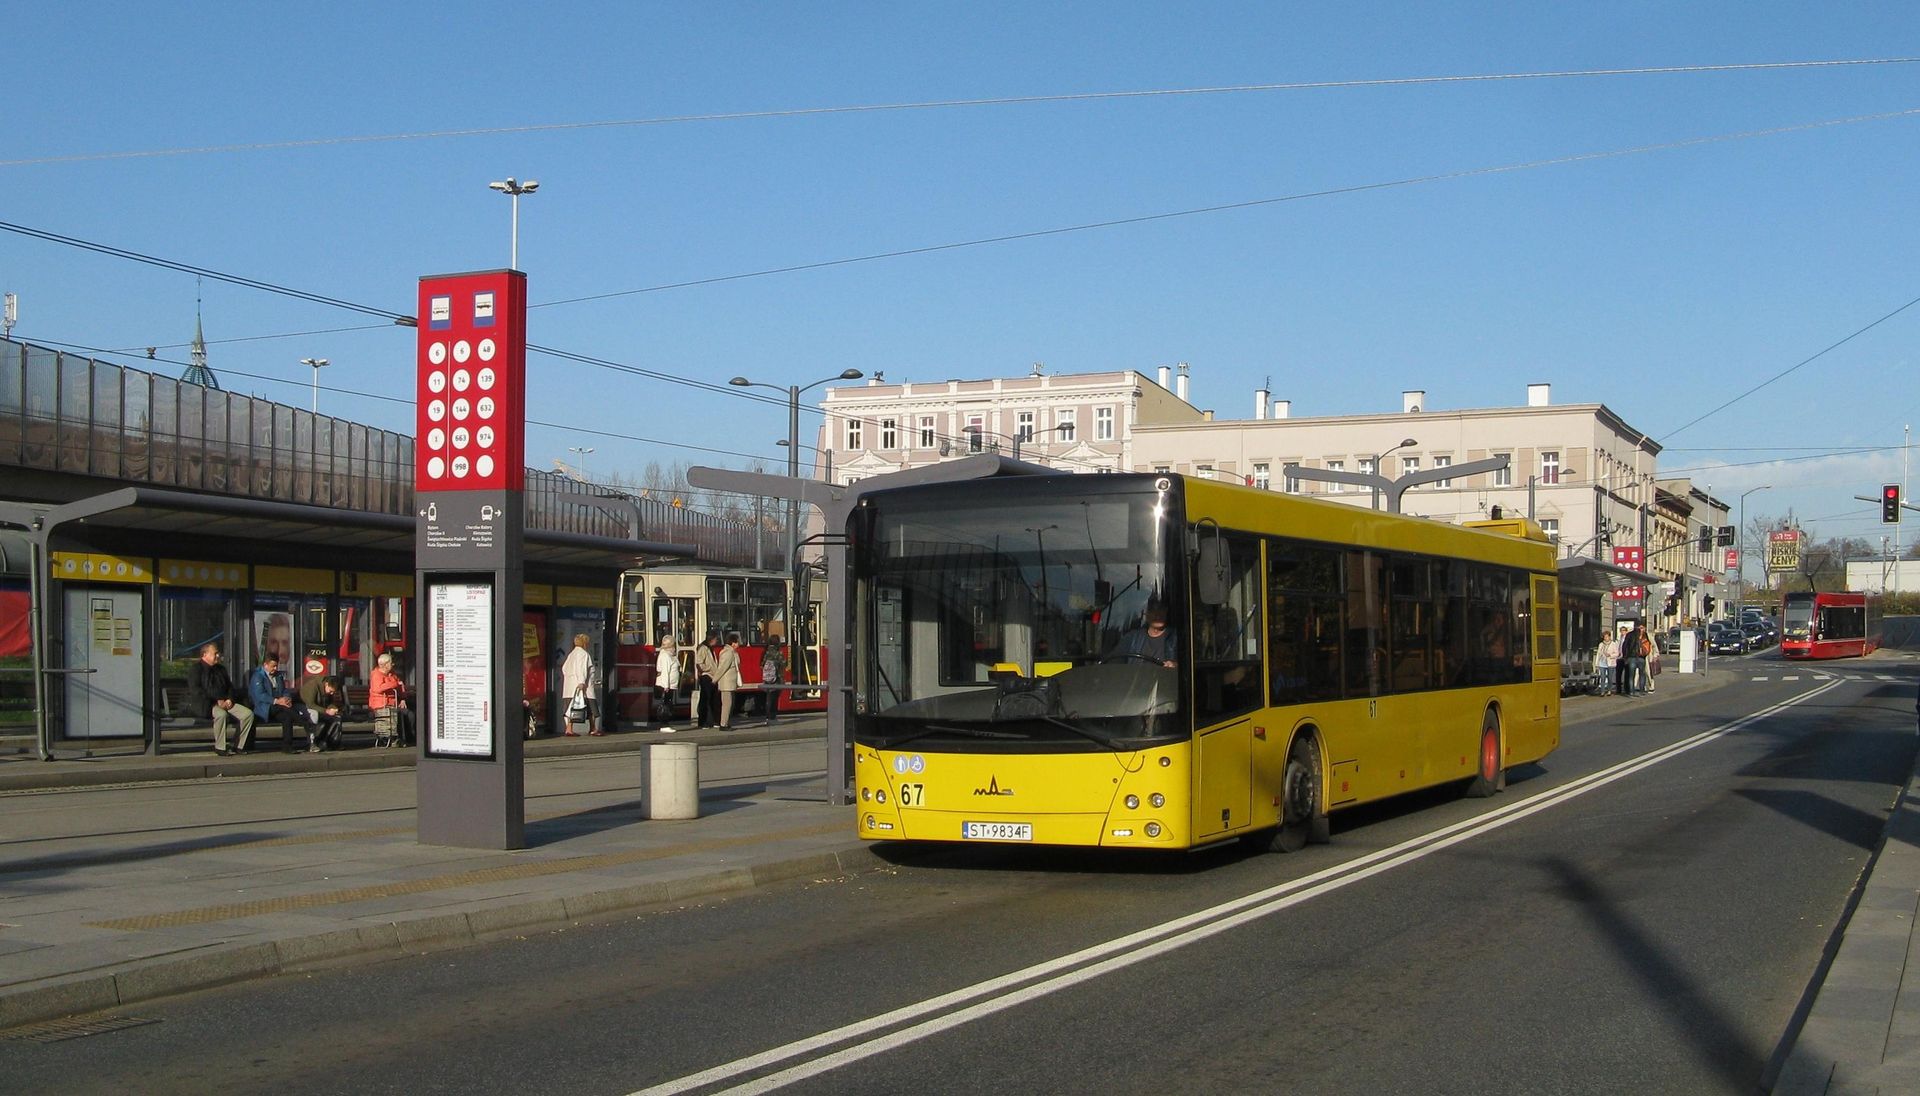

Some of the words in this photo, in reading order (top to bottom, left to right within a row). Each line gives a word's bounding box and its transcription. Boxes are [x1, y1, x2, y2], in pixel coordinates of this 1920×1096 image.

[482, 345, 491, 353] 48
[433, 378, 441, 386] 11
[457, 376, 466, 384] 74
[433, 406, 441, 414] 19
[455, 405, 467, 413] 144
[480, 404, 492, 412] 632
[455, 434, 467, 442] 663
[479, 433, 492, 441] 974
[1771, 556, 1796, 565] CENY!
[1370, 700, 1376, 718] 67
[900, 783, 924, 806] 67
[970, 824, 988, 838] ST
[992, 825, 1029, 839] 9834F
